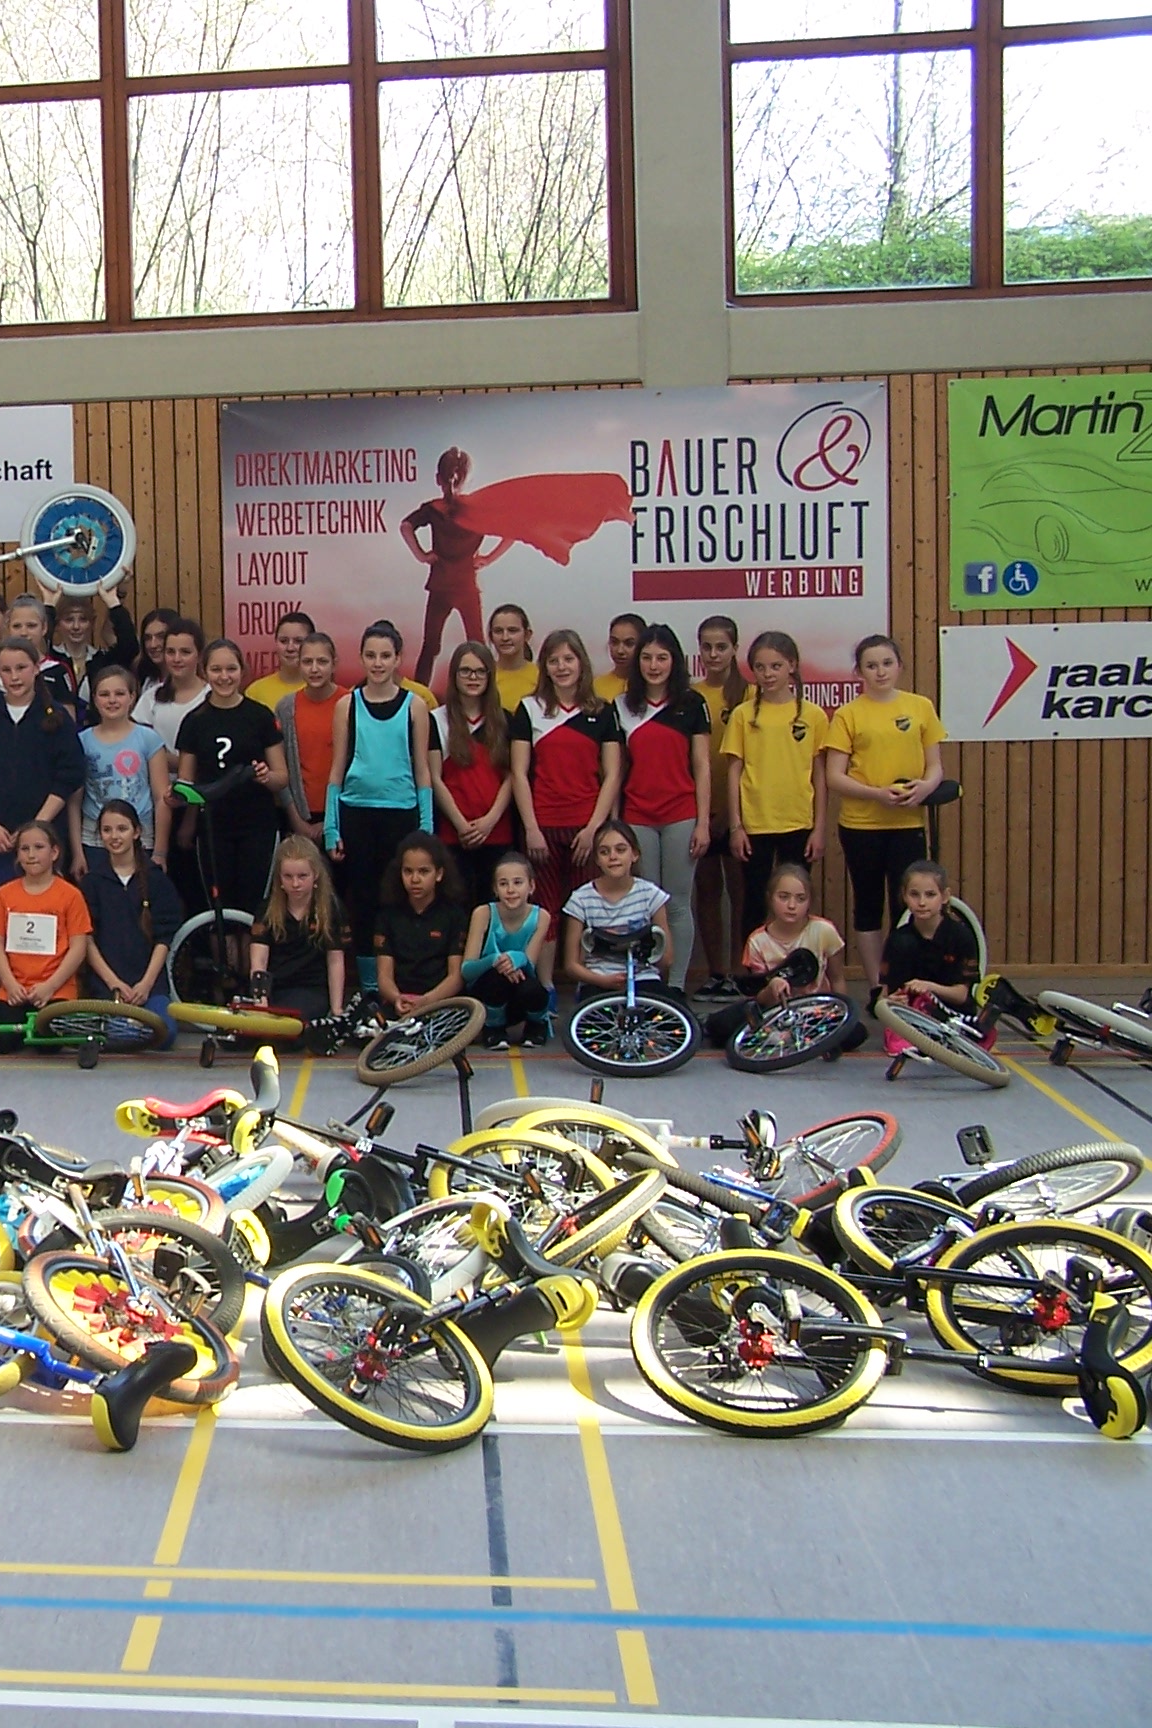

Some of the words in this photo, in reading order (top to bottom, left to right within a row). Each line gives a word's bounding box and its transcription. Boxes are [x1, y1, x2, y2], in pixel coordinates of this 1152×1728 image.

[978, 390, 1145, 437] Martin
[235, 448, 417, 487] DIREKTMARKETING
[630, 437, 758, 497] BAUER
[235, 499, 387, 537] WERBETECHNIK
[631, 501, 869, 564] FRISCHLUFT
[237, 551, 309, 586] LAYOUT
[745, 567, 859, 597] WERBUNG
[26, 921, 35, 934] 2
